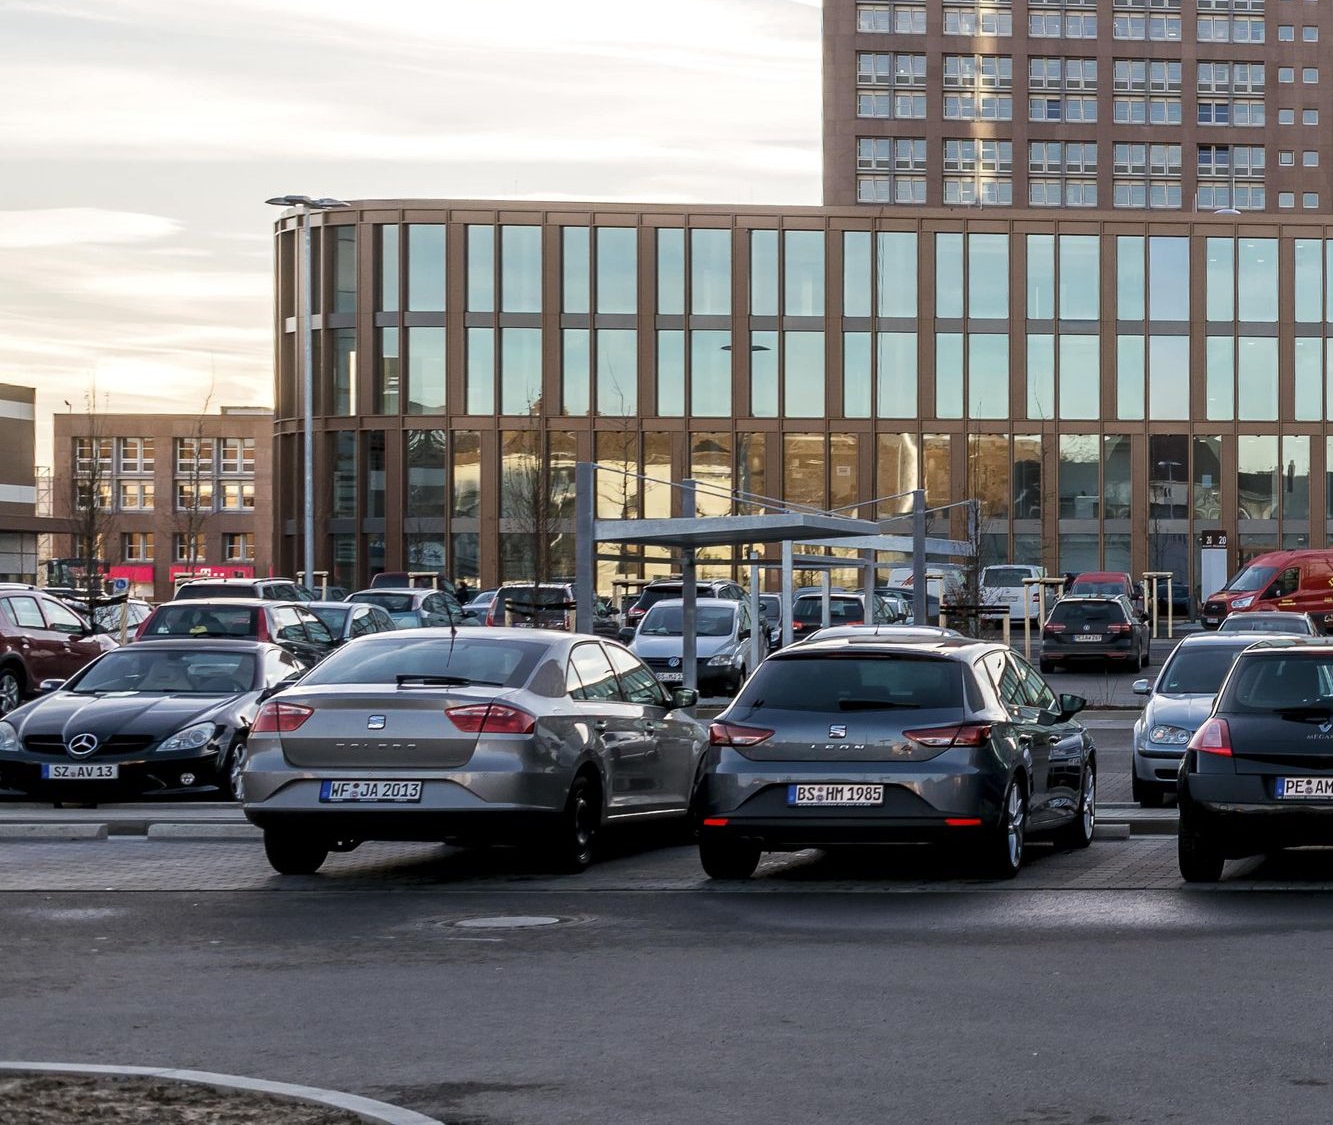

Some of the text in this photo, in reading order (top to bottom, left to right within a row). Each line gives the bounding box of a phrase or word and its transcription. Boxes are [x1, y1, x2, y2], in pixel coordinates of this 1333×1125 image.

[53, 766, 113, 778] SZ AV 13
[331, 782, 420, 798] WF JA 2013
[797, 786, 882, 801] BS HM 1985
[1286, 780, 1304, 794] PE
